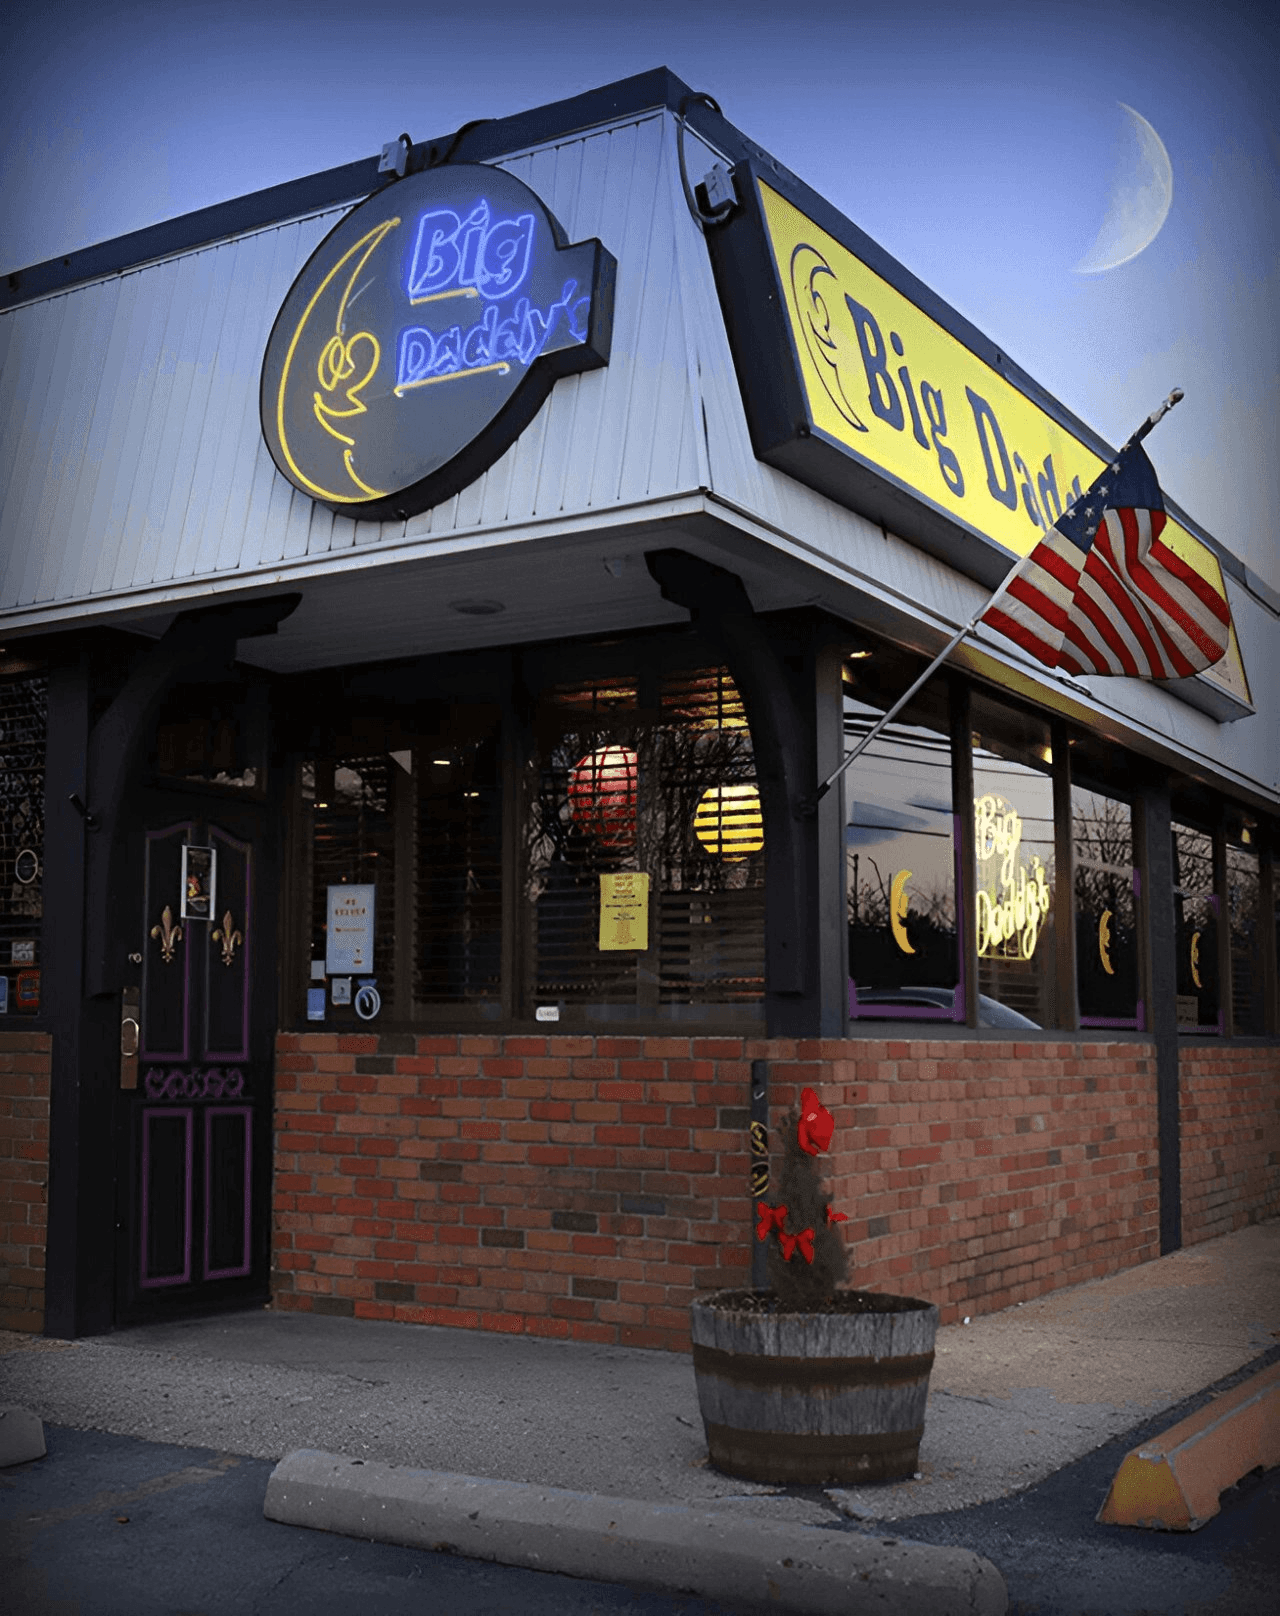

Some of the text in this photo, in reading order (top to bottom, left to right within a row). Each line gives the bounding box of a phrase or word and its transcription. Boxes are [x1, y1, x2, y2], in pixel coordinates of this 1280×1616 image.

[407, 199, 536, 300] Big
[844, 292, 966, 499] Big
[973, 795, 1023, 887] Big
